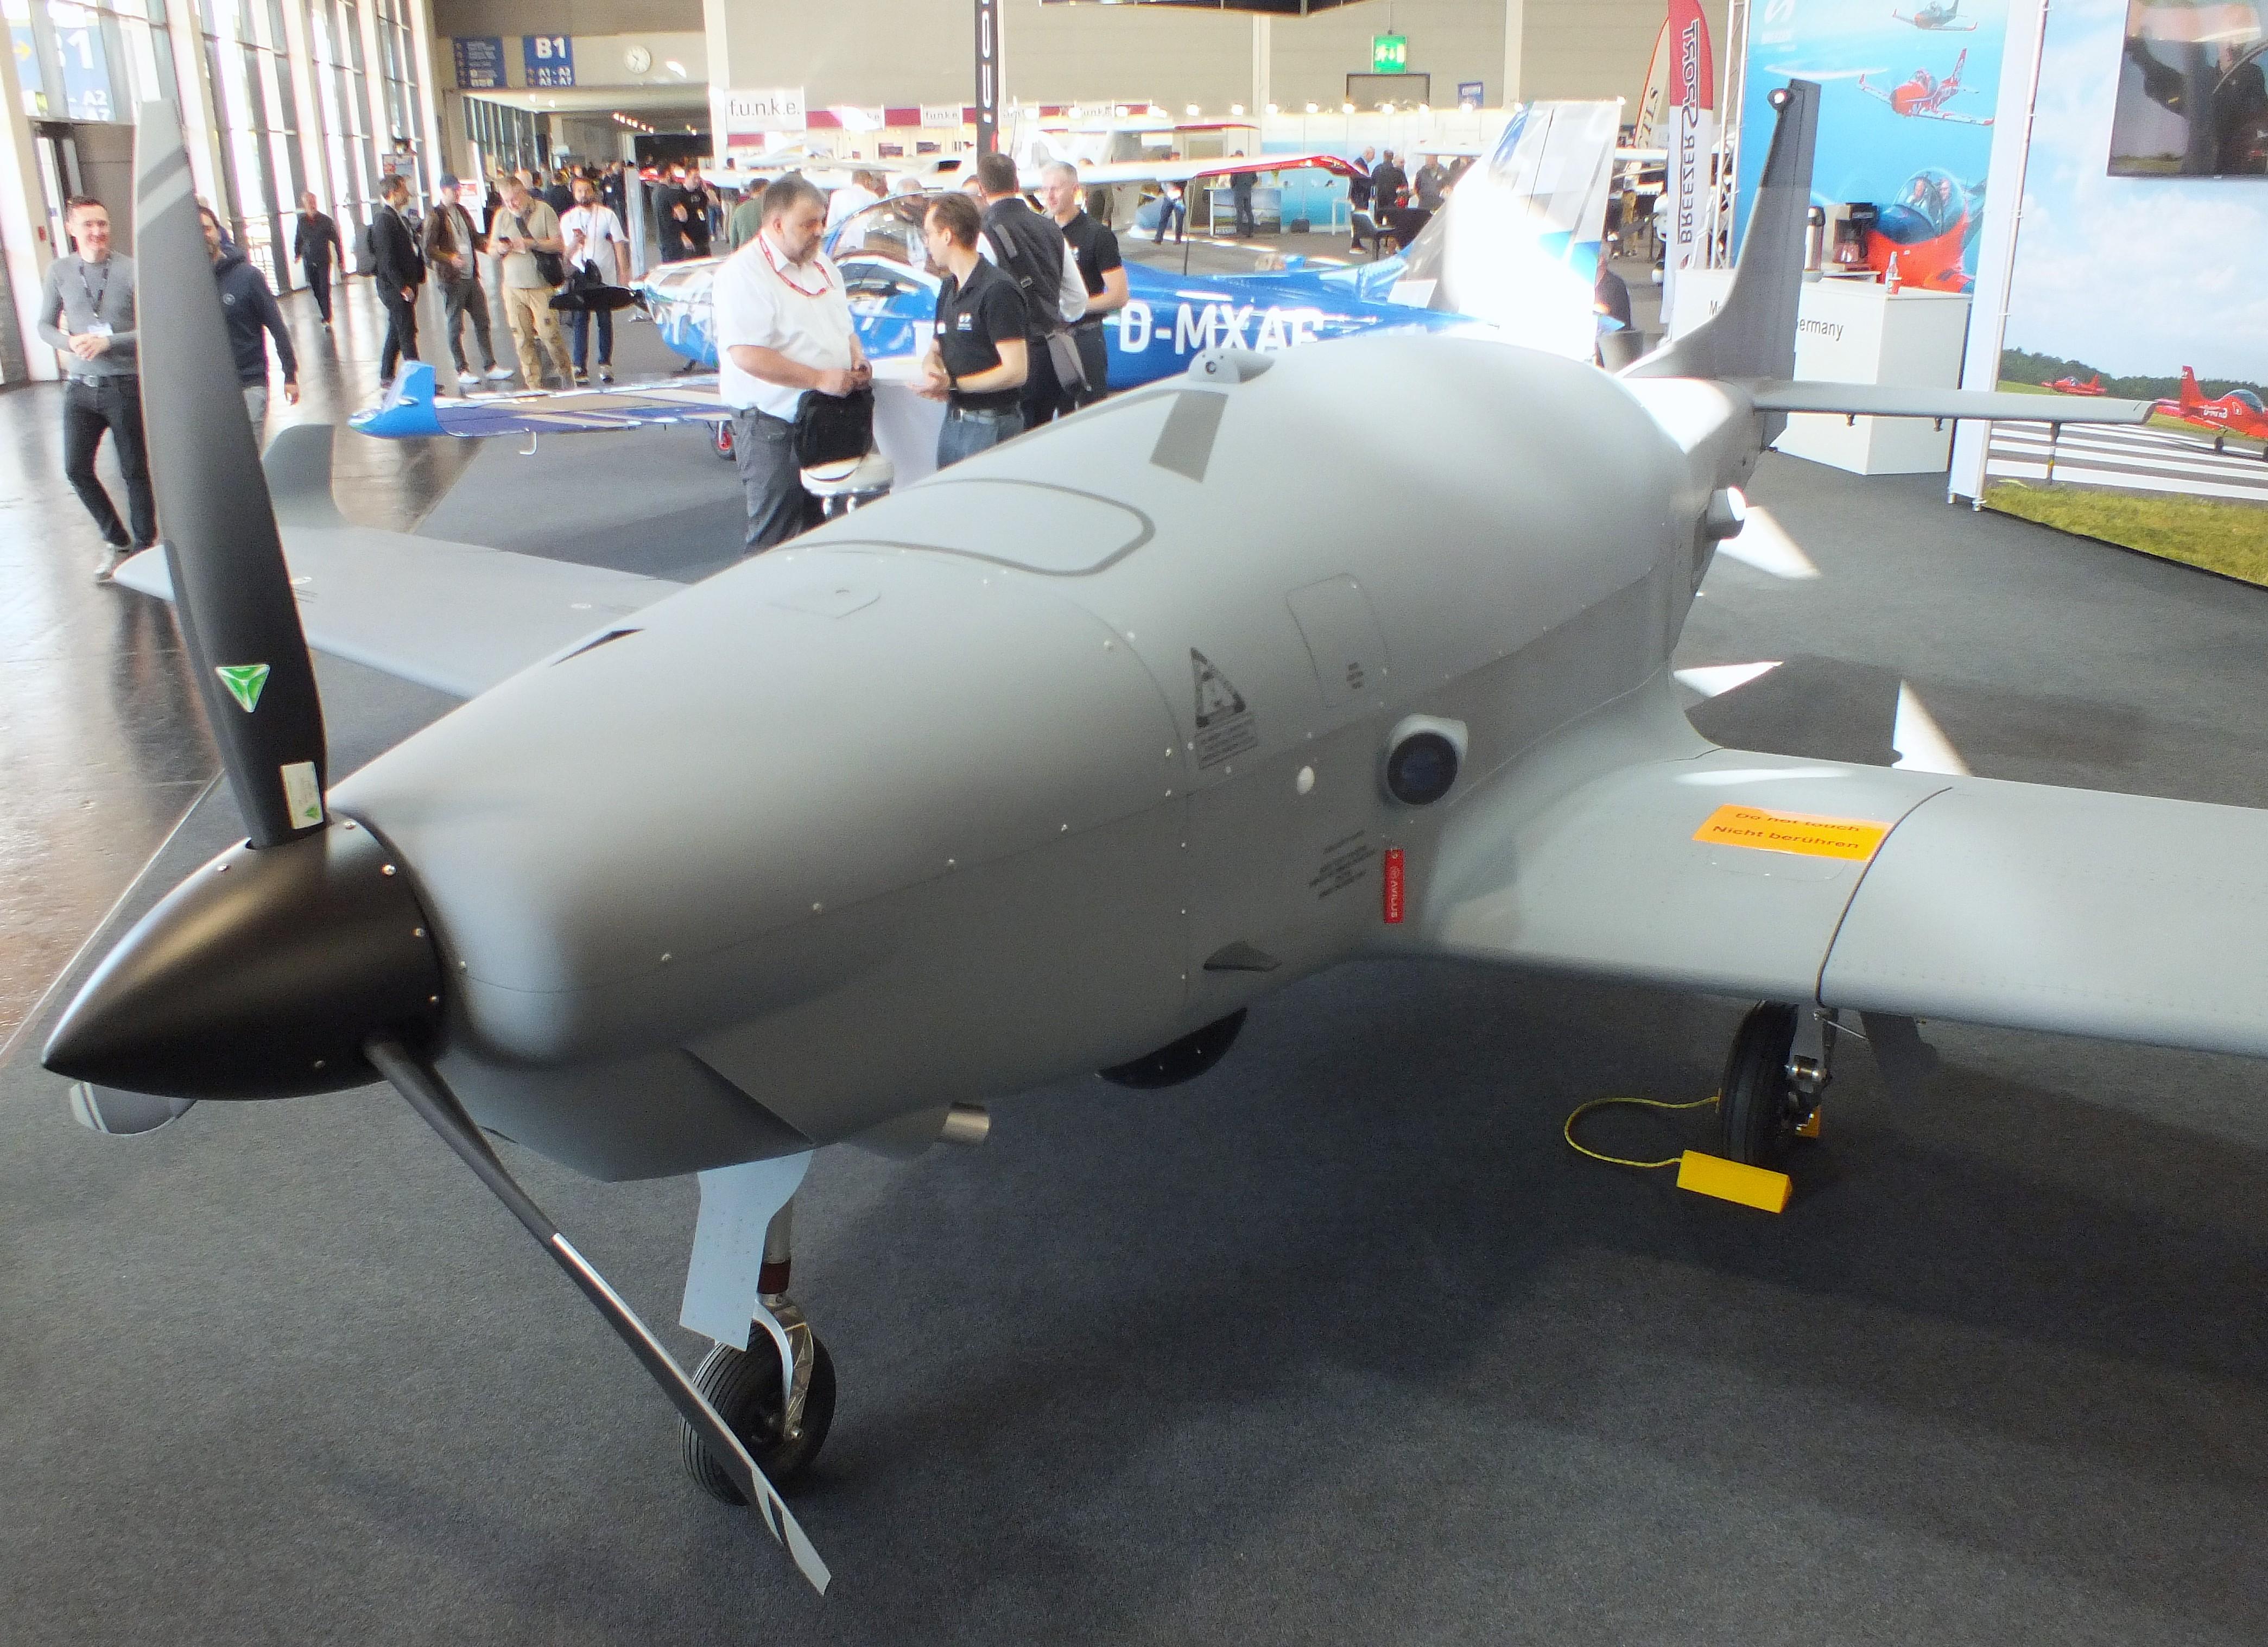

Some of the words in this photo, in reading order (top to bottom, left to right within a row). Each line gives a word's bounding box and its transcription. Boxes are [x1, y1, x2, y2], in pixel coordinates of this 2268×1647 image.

[535, 37, 566, 59] B1
[83, 90, 107, 105] A2
[1798, 318, 1843, 341] ermany
[1713, 825, 1764, 837] Nicht
[1769, 832, 1859, 848] berühren
[1805, 821, 1860, 832] touch
